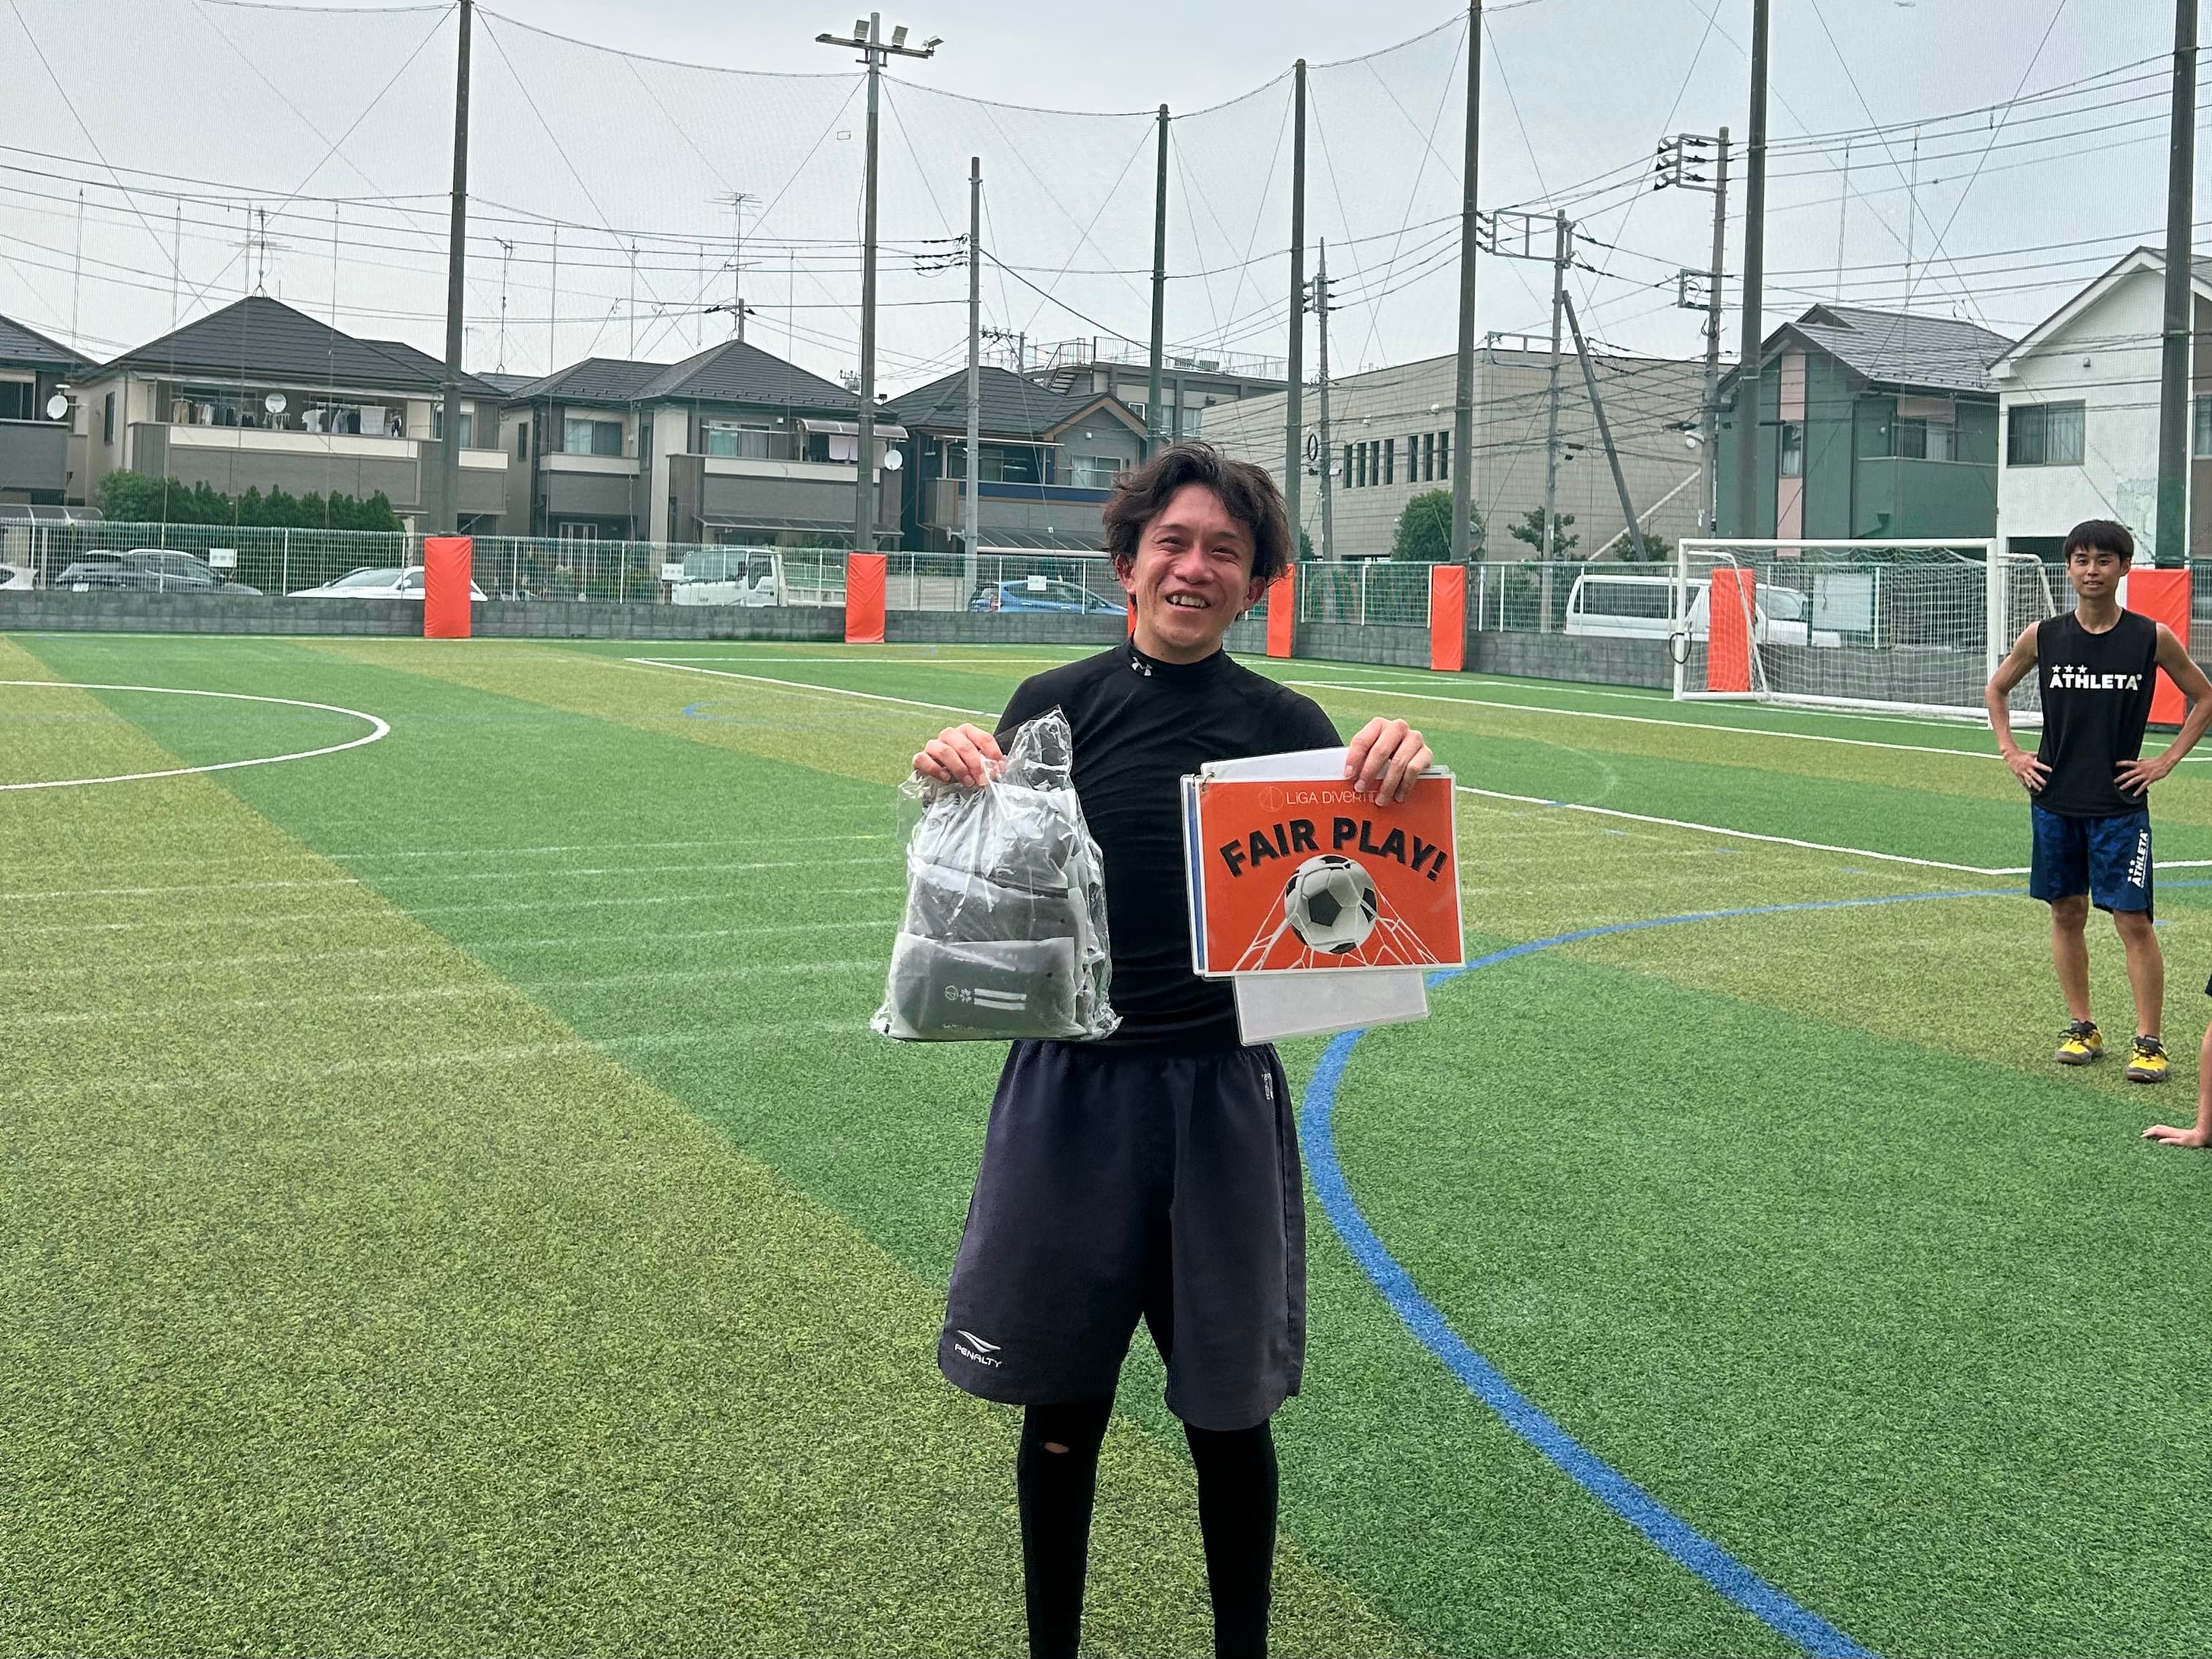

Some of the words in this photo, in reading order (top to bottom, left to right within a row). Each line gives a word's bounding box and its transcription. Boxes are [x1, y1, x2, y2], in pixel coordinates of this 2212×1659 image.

[2050, 673, 2138, 691] ATHLETA
[1219, 818, 1319, 878] FAIR
[1332, 817, 1448, 882] PLAY!
[2131, 833, 2149, 887] ATHLETA
[954, 1343, 1002, 1368] PENALTY
